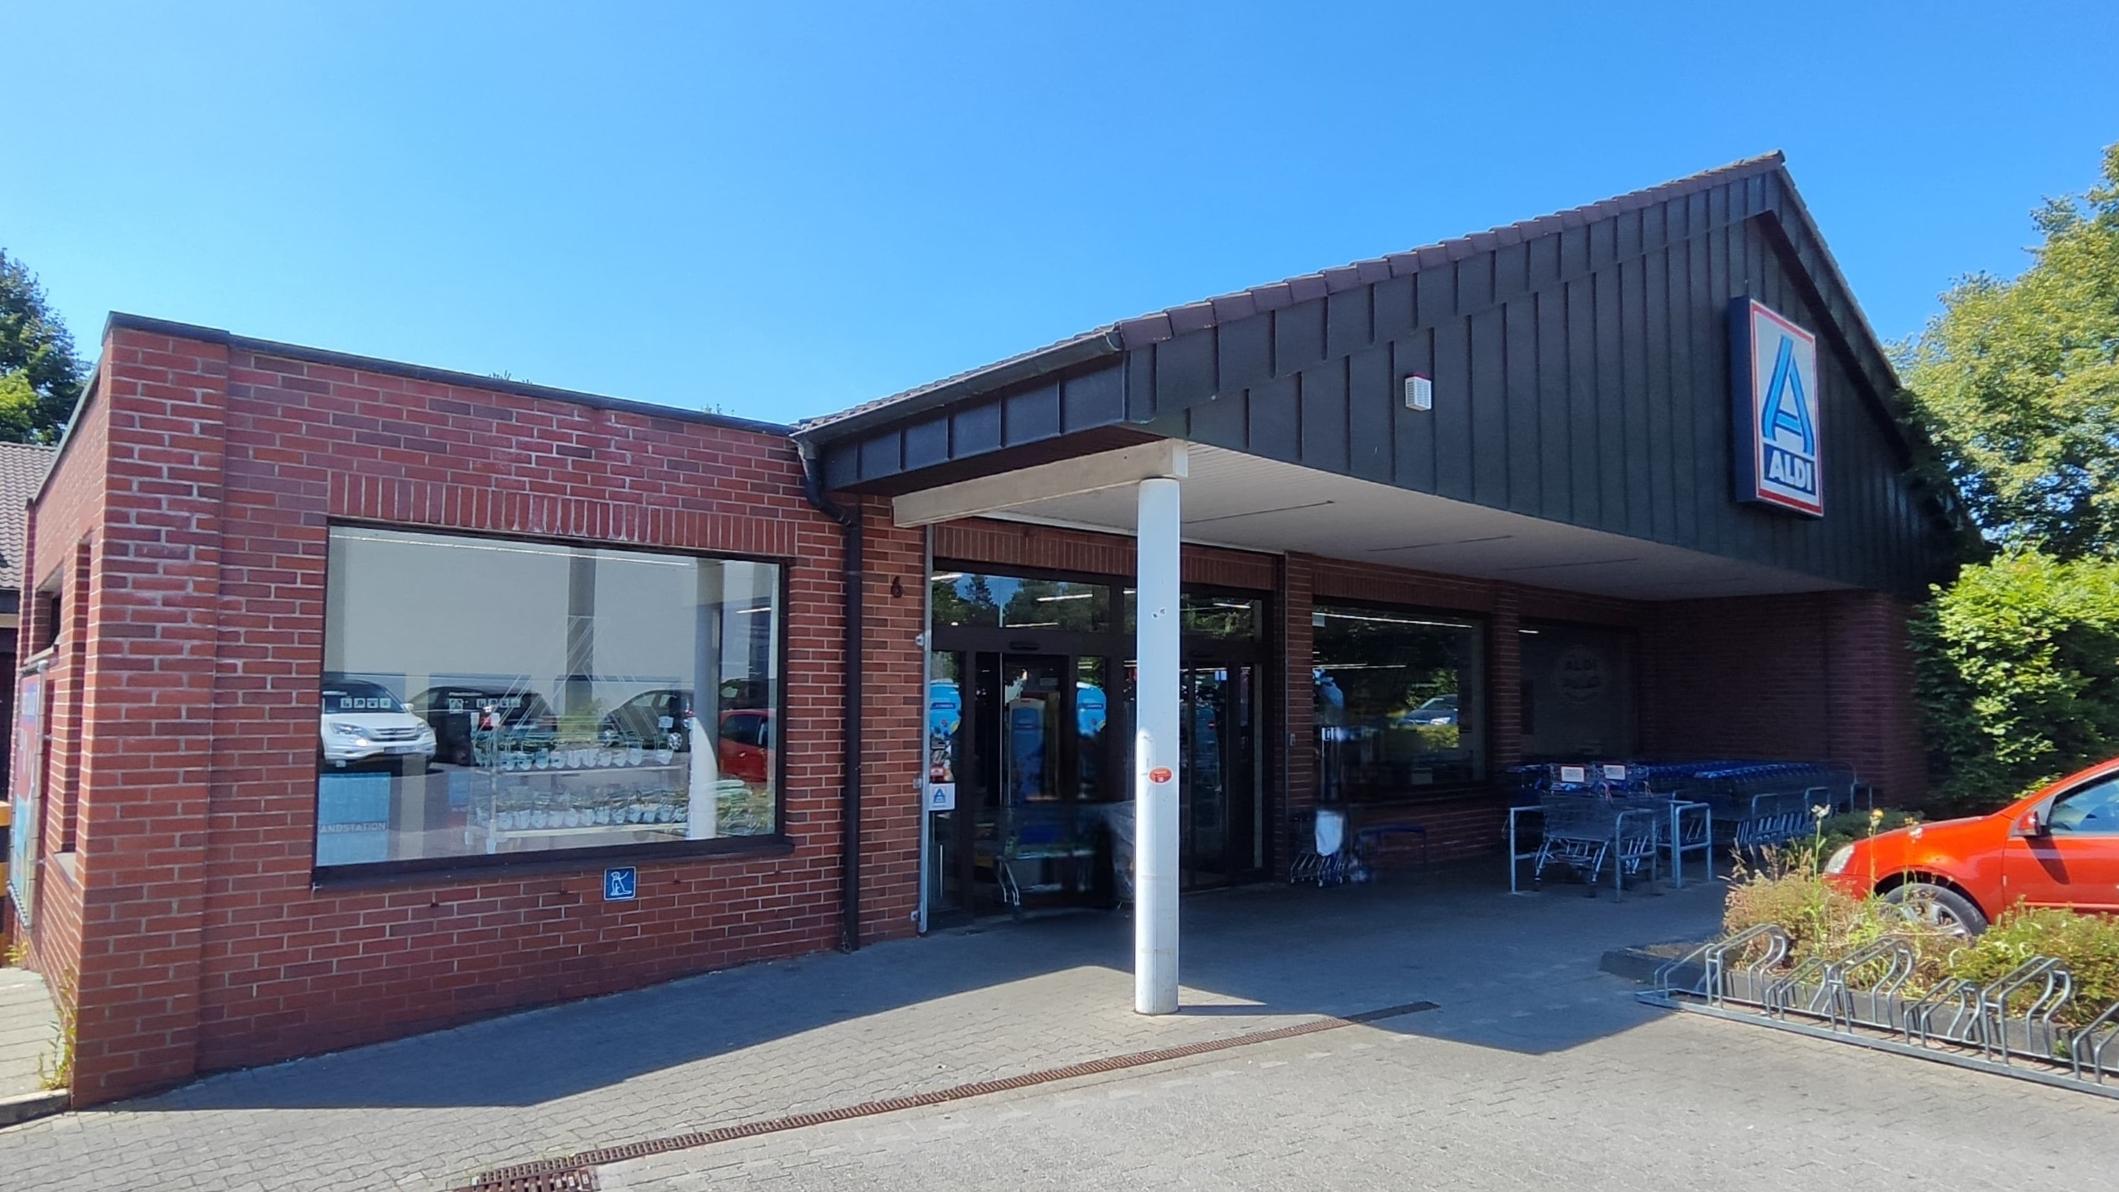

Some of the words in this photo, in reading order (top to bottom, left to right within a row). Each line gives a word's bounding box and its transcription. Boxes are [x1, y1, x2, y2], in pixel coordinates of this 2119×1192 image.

[1769, 449, 1813, 492] ALDI
[890, 575, 903, 598] 6
[319, 821, 387, 833] ANDSTATION
